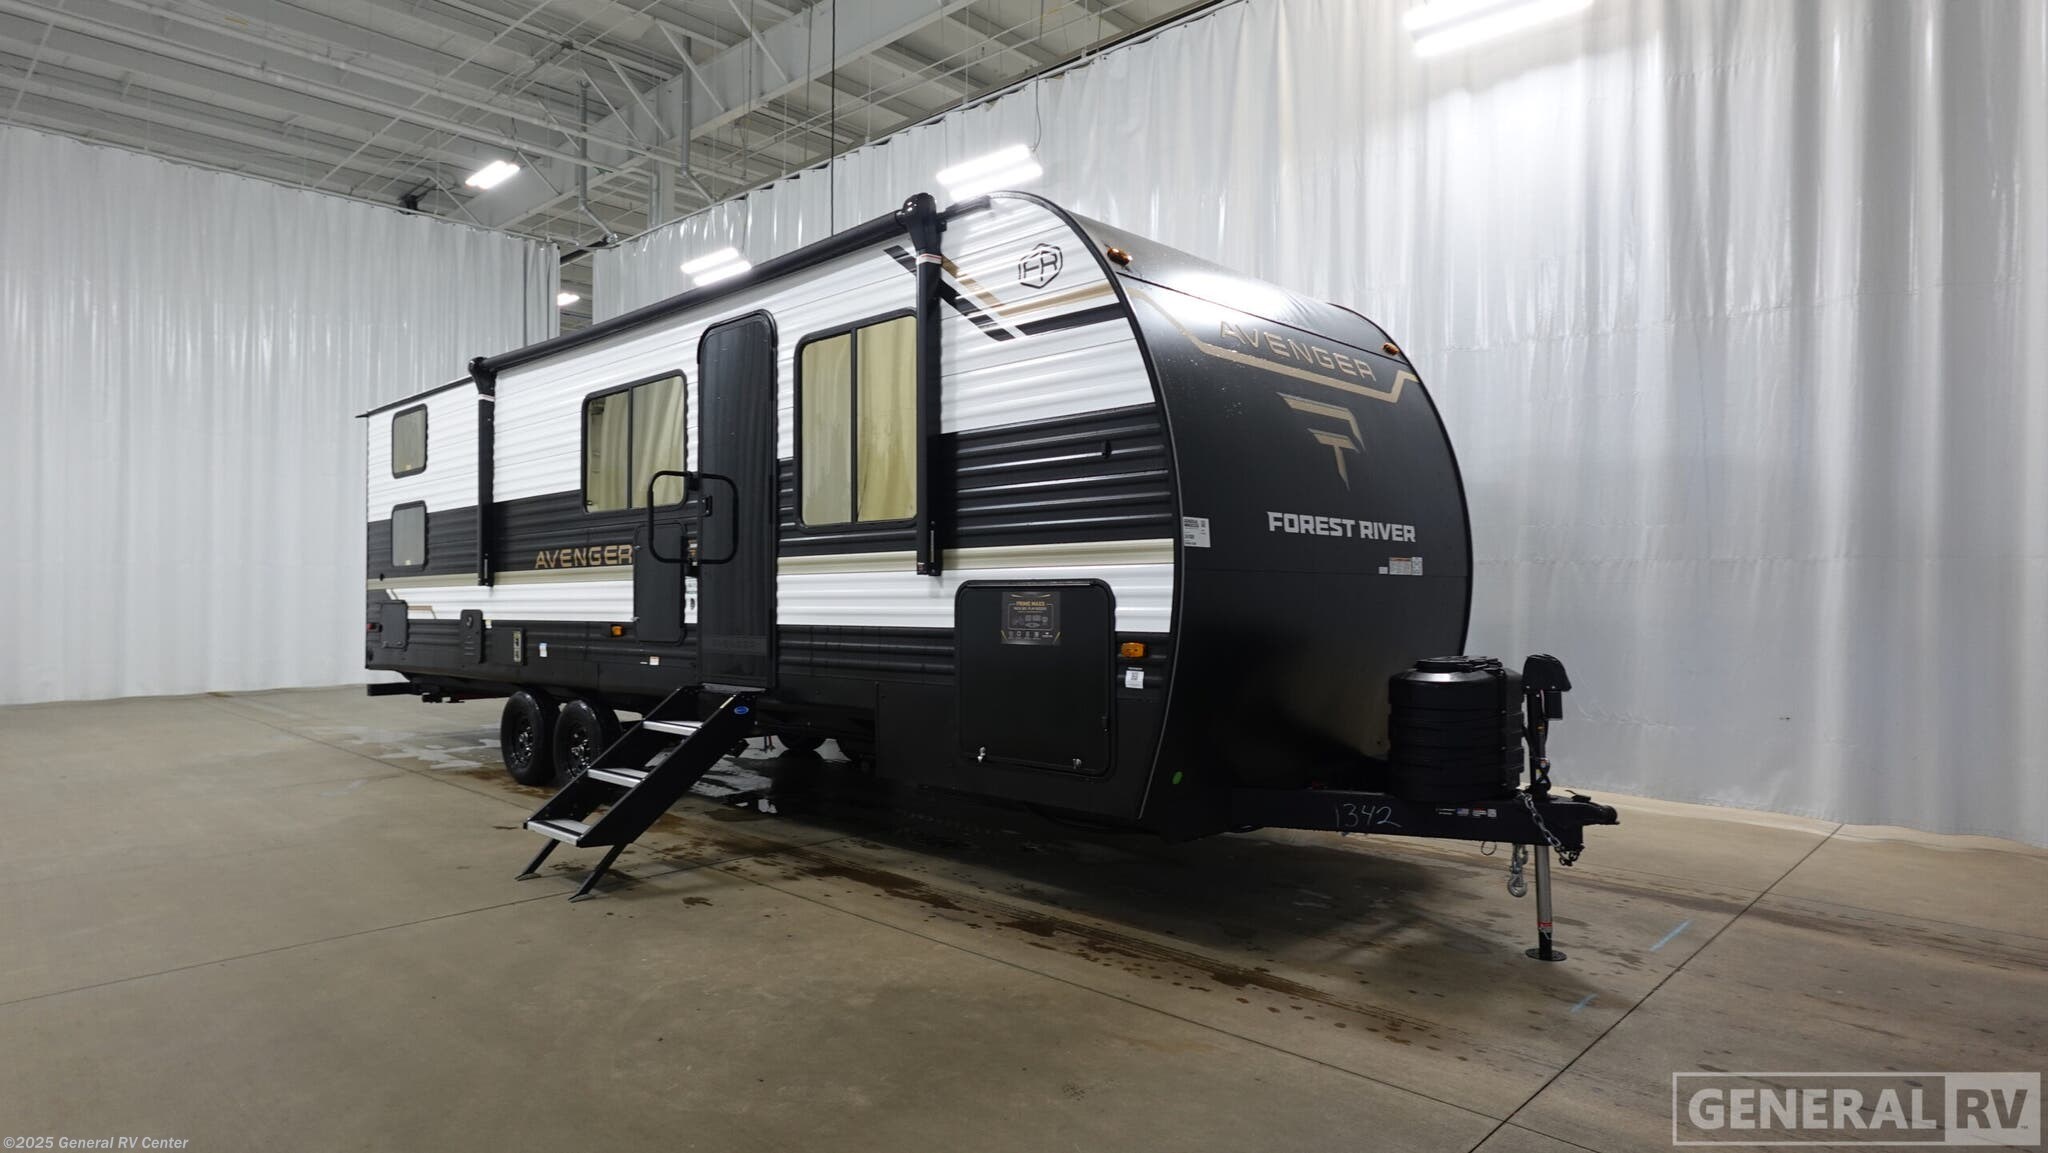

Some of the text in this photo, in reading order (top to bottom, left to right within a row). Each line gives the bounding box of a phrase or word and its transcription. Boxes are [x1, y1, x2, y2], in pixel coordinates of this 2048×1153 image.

[1219, 319, 1377, 382] AVENGER
[1267, 511, 1416, 543] FOREST RIVER
[535, 545, 633, 569] AVENGER
[1335, 802, 1402, 828] 1342
